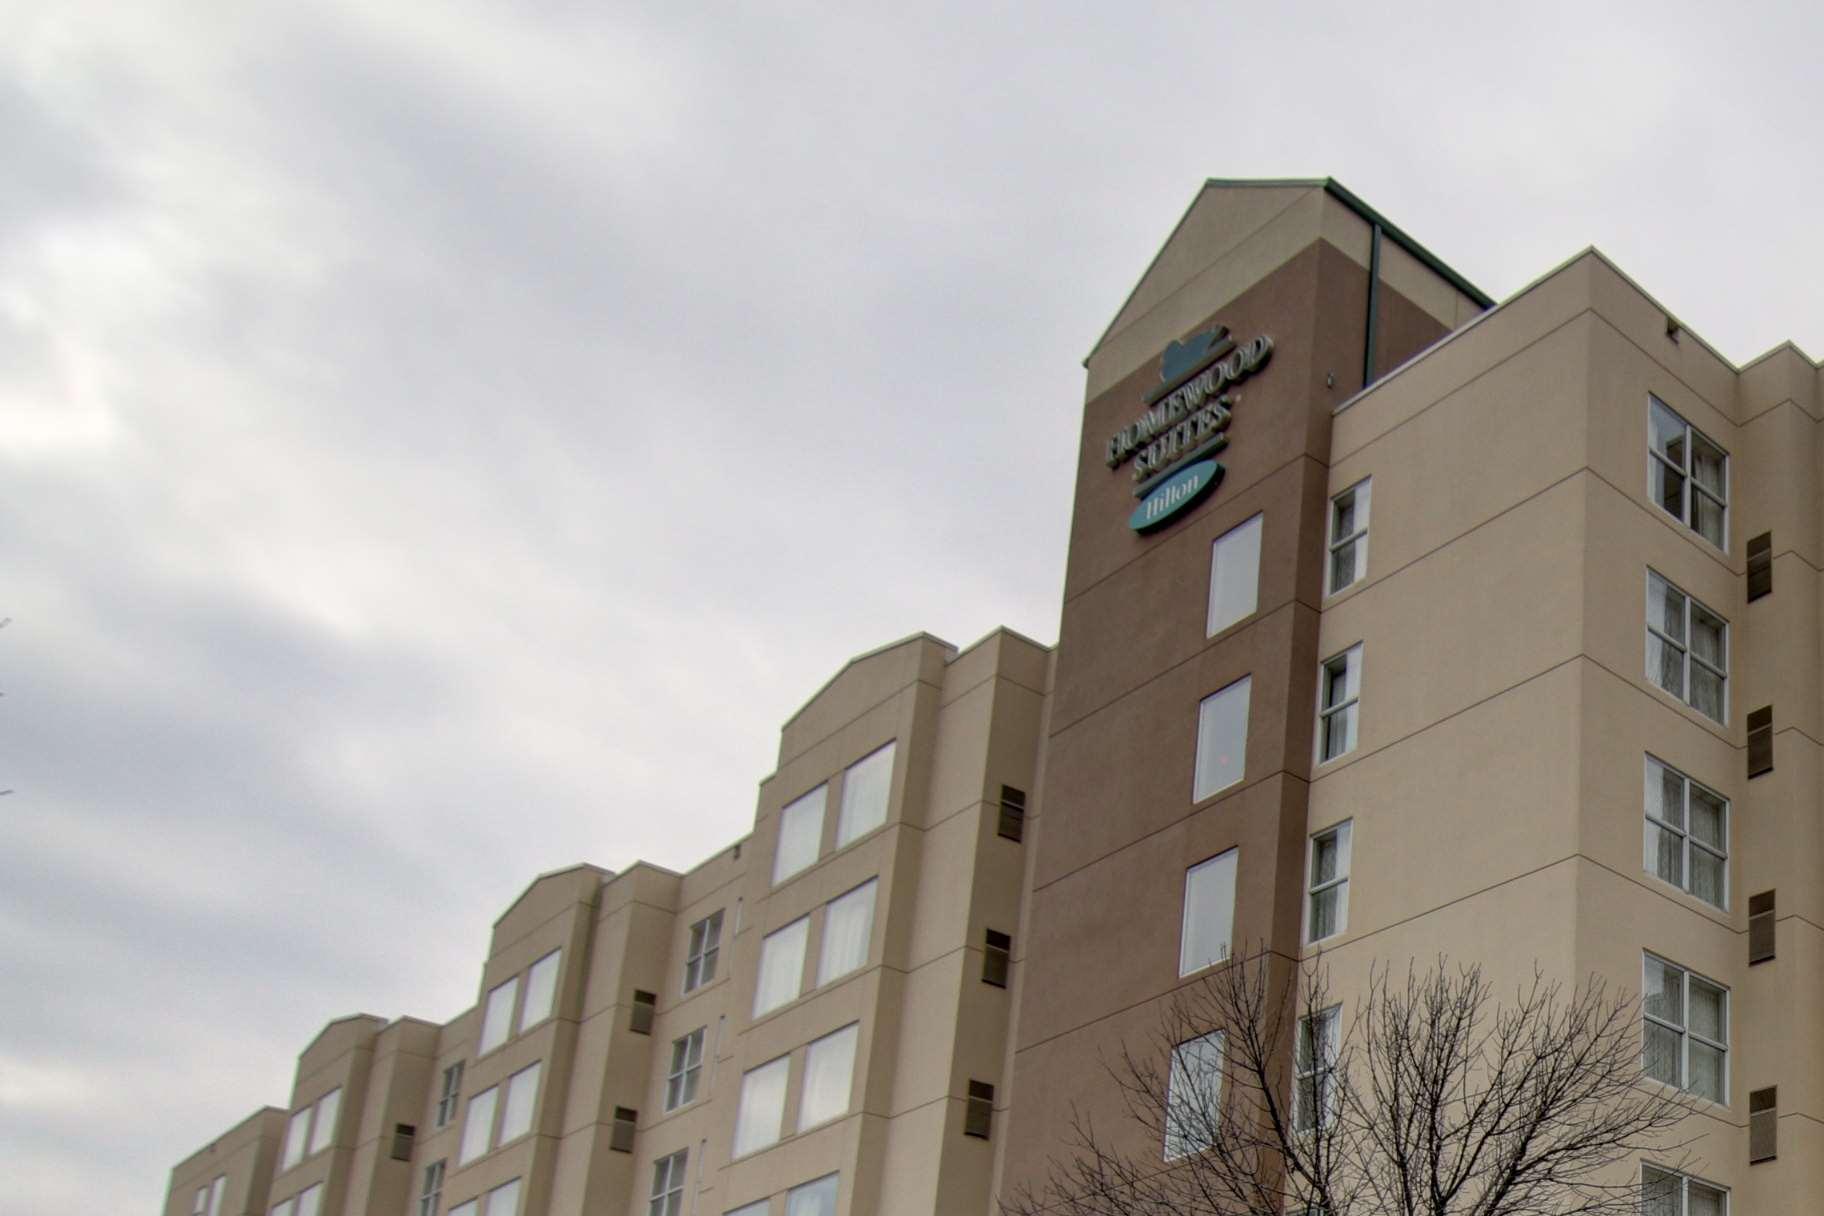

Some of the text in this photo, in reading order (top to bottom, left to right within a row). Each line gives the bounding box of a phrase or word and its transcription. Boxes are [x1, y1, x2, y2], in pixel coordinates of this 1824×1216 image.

[1105, 334, 1275, 469] HOMEWOOD
[1133, 395, 1233, 482] SUITES
[1144, 474, 1201, 520] Hilton
